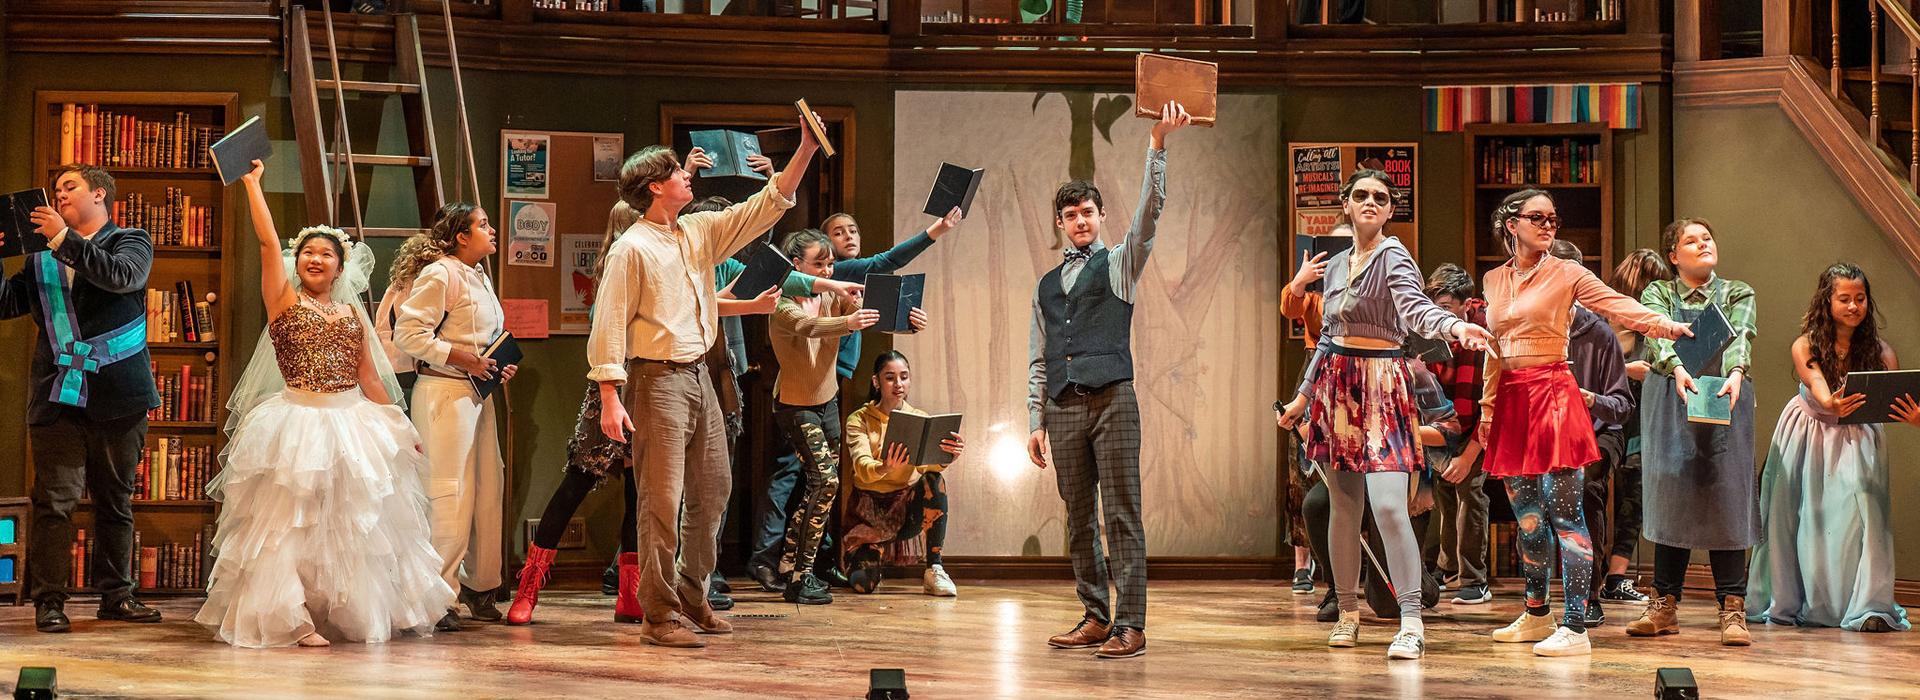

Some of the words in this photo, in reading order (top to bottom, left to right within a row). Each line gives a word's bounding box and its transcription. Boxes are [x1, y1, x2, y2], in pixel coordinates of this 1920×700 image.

[510, 154, 515, 162] A
[1298, 150, 1322, 162] Calling
[1385, 160, 1410, 172] BOOK
[1303, 172, 1334, 182] MUSICALS
[1388, 174, 1410, 186] LUB
[1298, 183, 1338, 192] RE-IMAGINED
[1304, 215, 1336, 224] YARD
